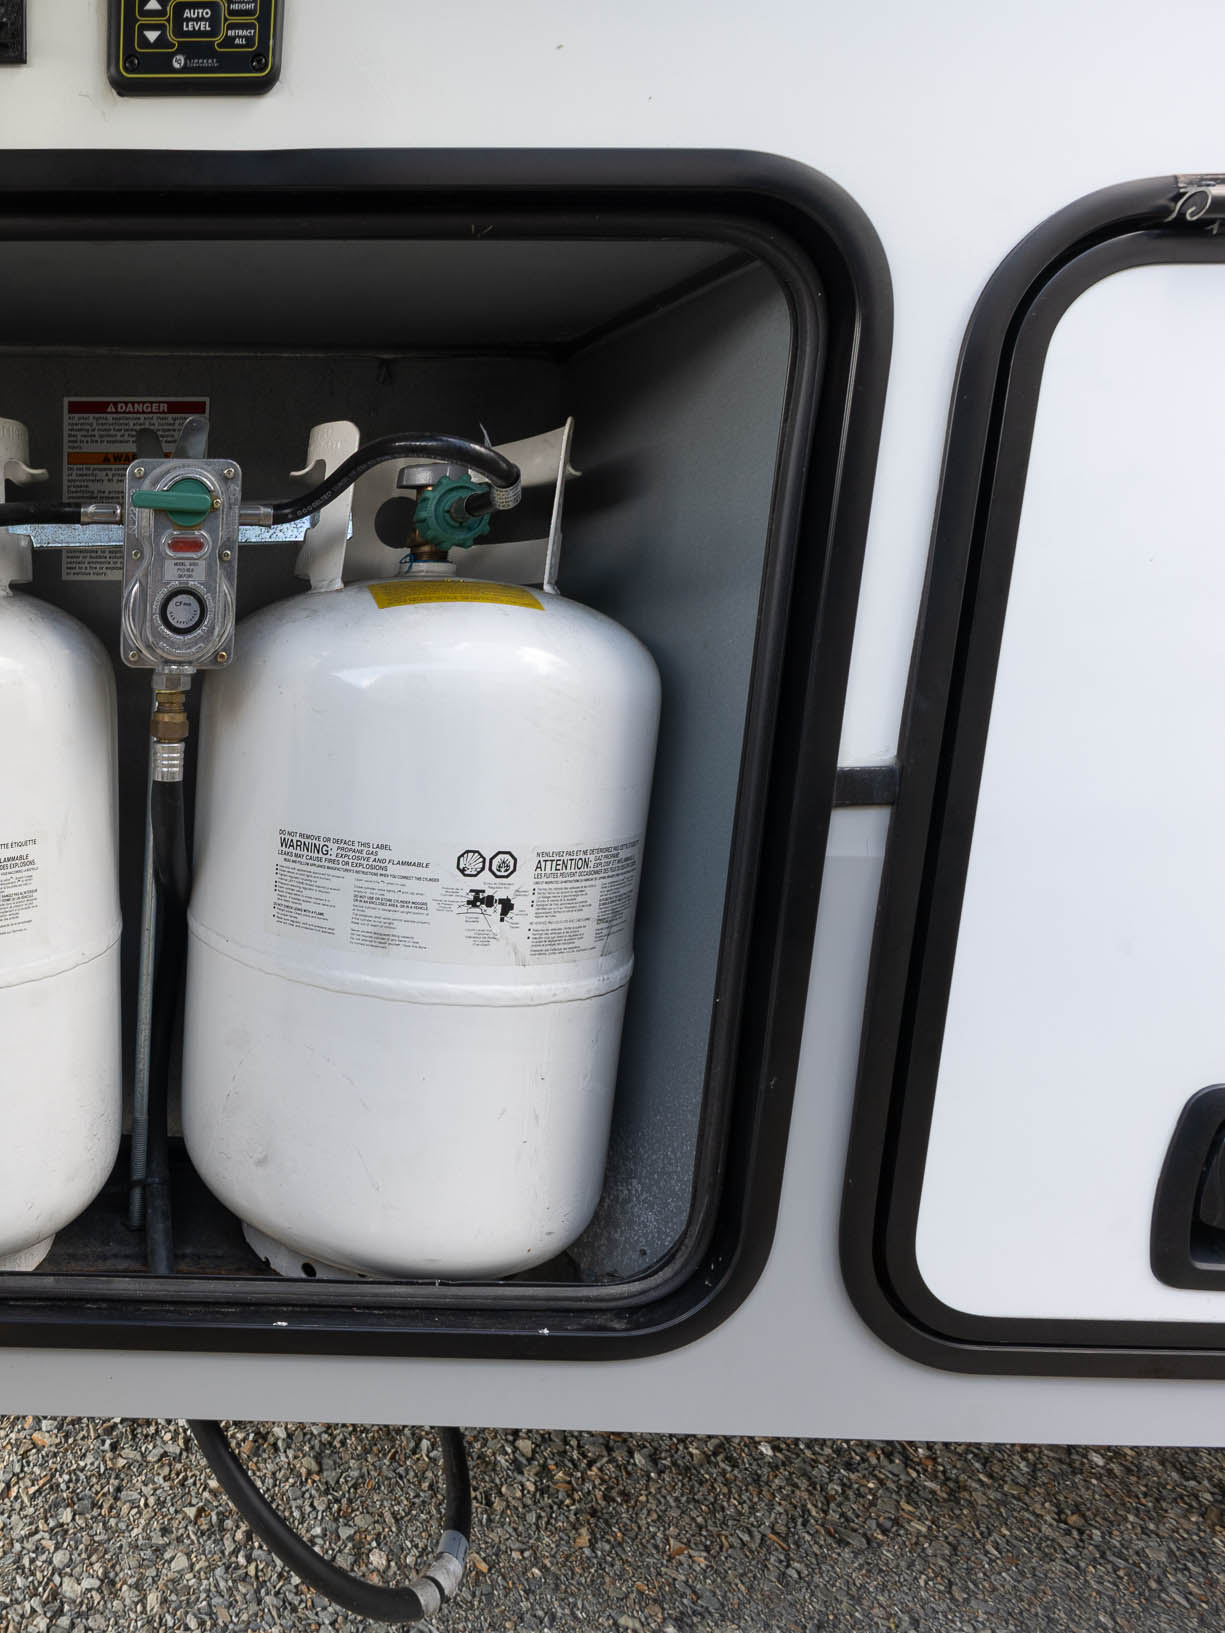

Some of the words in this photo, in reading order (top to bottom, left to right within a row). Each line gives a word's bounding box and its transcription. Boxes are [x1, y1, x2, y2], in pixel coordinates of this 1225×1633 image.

[183, 9, 211, 18] AUTO
[183, 22, 211, 31] LEVEL
[117, 403, 168, 413] DANGER
[279, 836, 333, 857] WARNING:
[299, 833, 321, 842] REMOVE
[332, 838, 355, 847] DEFACE
[372, 843, 392, 851] LABEL
[336, 846, 364, 855] PROPANE
[365, 849, 378, 857] GAS
[9, 859, 36, 871] EXPLOSIONS
[277, 850, 293, 858] LEAKS
[305, 854, 323, 863] CAUSE
[324, 857, 340, 866] FIRES
[351, 861, 388, 872] EXPLOSIONS
[335, 853, 371, 863] EXPLOSIVE
[372, 857, 386, 865] AND
[387, 860, 430, 869] FLAMMABLE
[534, 857, 592, 872] ATTENTION:
